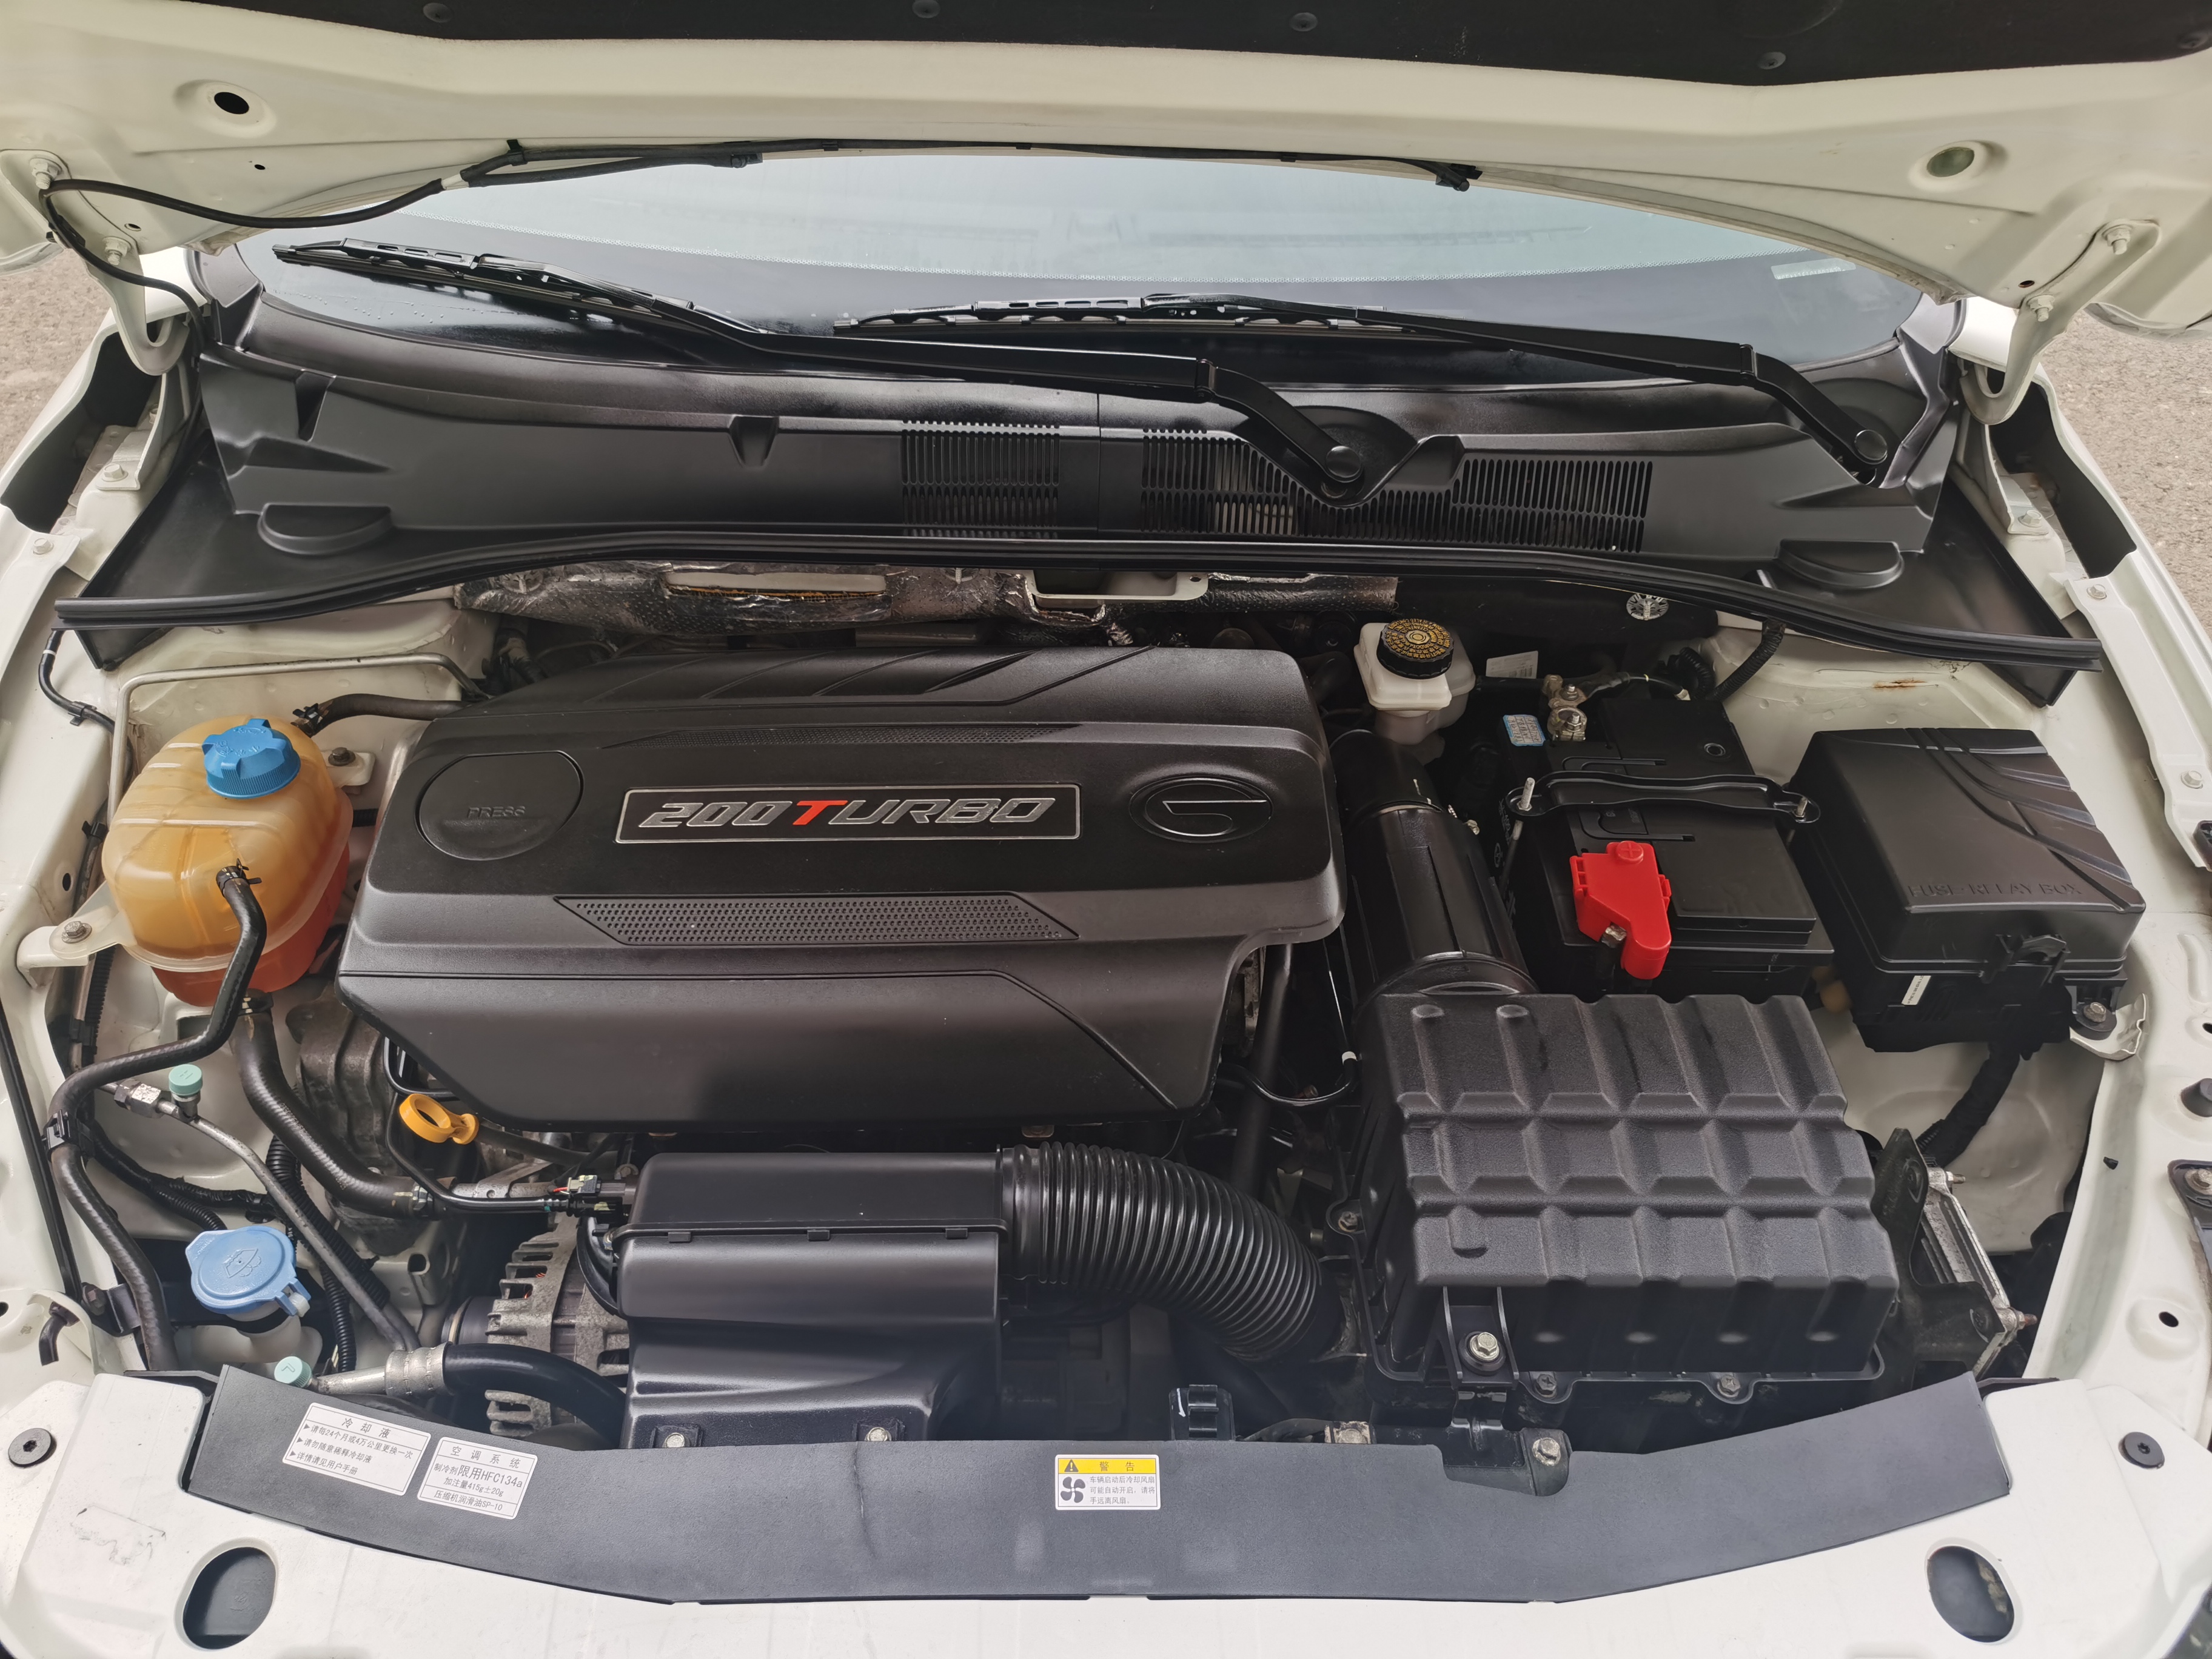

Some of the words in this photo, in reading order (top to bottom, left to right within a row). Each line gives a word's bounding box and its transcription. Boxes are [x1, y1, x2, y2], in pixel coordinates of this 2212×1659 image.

[466, 805, 526, 819] PRESS
[638, 798, 1056, 828] 200TURBO
[2038, 883, 2083, 896] BOX
[342, 1418, 391, 1439] 冷却液
[303, 1438, 372, 1463] 请勿随意稀释冷却液
[310, 1424, 414, 1460] 请每24个月或4万公里更换一次
[295, 1451, 358, 1475] 详情请见用户手册
[450, 1446, 521, 1469] 空调系统
[1099, 1461, 1134, 1472] 警告
[434, 1463, 522, 1489] 制冷剂限用HFC134a
[443, 1476, 504, 1497] 加注量415g±20g
[434, 1490, 503, 1512] 压缩机润滑油SP-10
